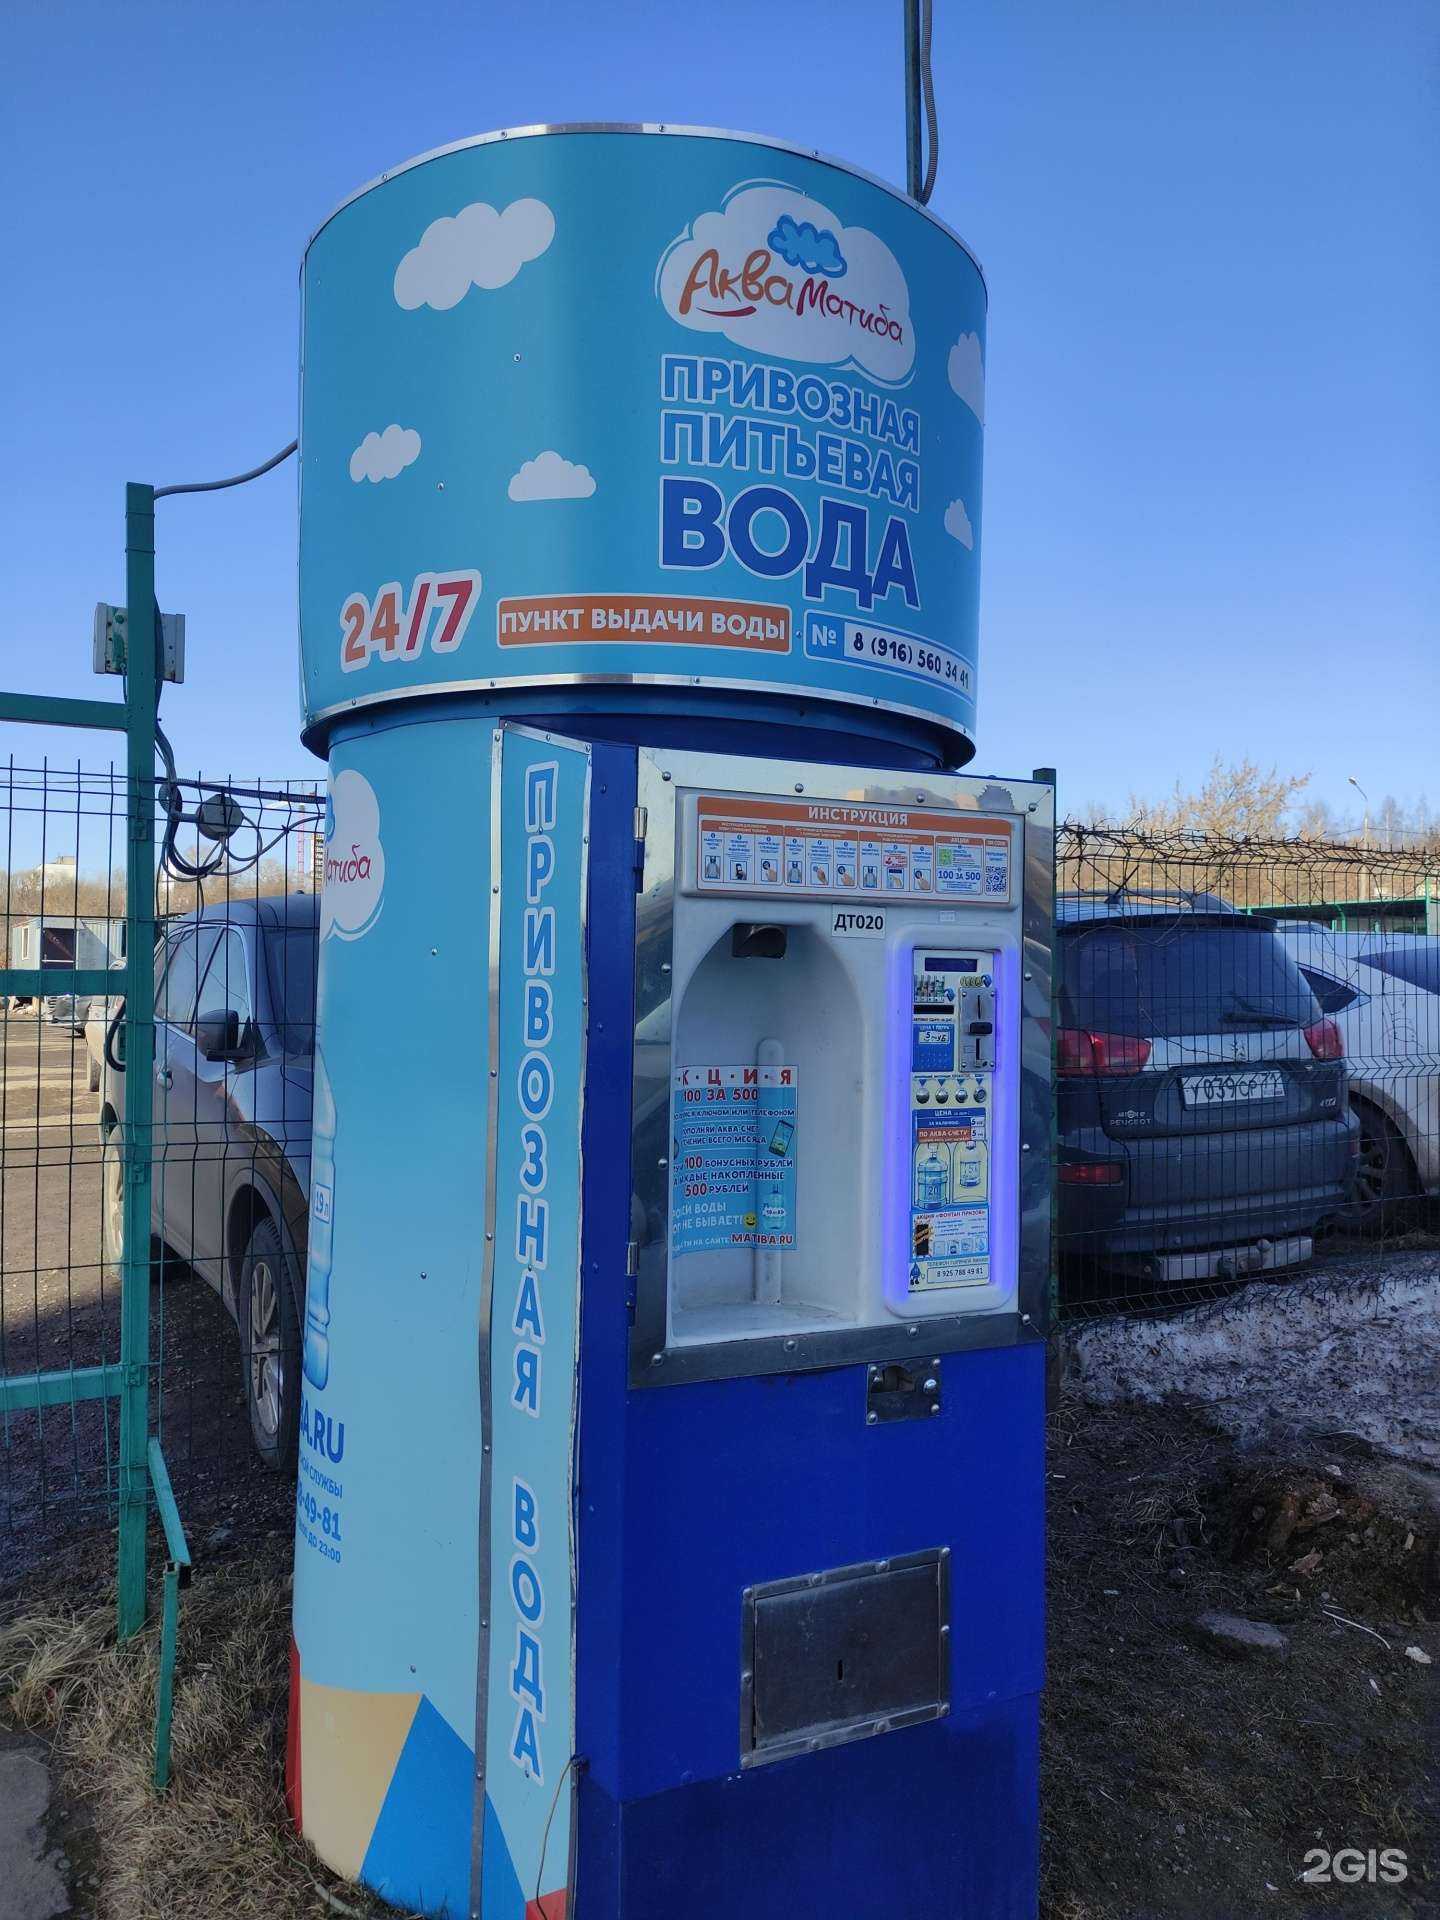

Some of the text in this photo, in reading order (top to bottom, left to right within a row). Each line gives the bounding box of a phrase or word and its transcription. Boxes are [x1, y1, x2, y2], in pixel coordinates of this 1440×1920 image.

[661, 354, 921, 457] ПРИВОЗНАЯ
[661, 410, 920, 513] ПИТЬЕВАЯ
[659, 475, 921, 611] ВОДА
[343, 573, 478, 669] 24/7
[501, 608, 786, 641] ПУНКТ ВЫДАЧИ ВОДЫ
[811, 624, 836, 647] №
[853, 632, 864, 651] 8
[871, 637, 912, 664] (916)
[917, 650, 941, 674] 560
[945, 662, 958, 679] 34
[808, 806, 908, 826] ИНСТРУКЦИЯ
[326, 843, 371, 884] атиба
[937, 870, 954, 880] 100
[965, 871, 981, 882] 500
[834, 913, 884, 930] ДТ020
[513, 762, 557, 1417] ПРИВОЗНАЯ
[683, 1088, 759, 1101] 100 ЗА 500
[751, 1108, 795, 1117] ТЕЛЕФОНОМ
[709, 1136, 732, 1144] ВСЕГО
[734, 1135, 767, 1144] МЕСЯЦА
[685, 1156, 703, 1169] 100
[705, 1159, 755, 1168] БОНУСНЫХ
[711, 1171, 785, 1180] НАКОПЛЕННЫЕ
[685, 1183, 707, 1197] 500
[694, 1202, 727, 1213] ВОДЫ
[731, 1234, 793, 1245] MATIBA.RU
[309, 1465, 343, 1499] СЛУЖБЫ
[318, 1540, 341, 1563] 23:00
[511, 1477, 545, 1785] ВОДА
